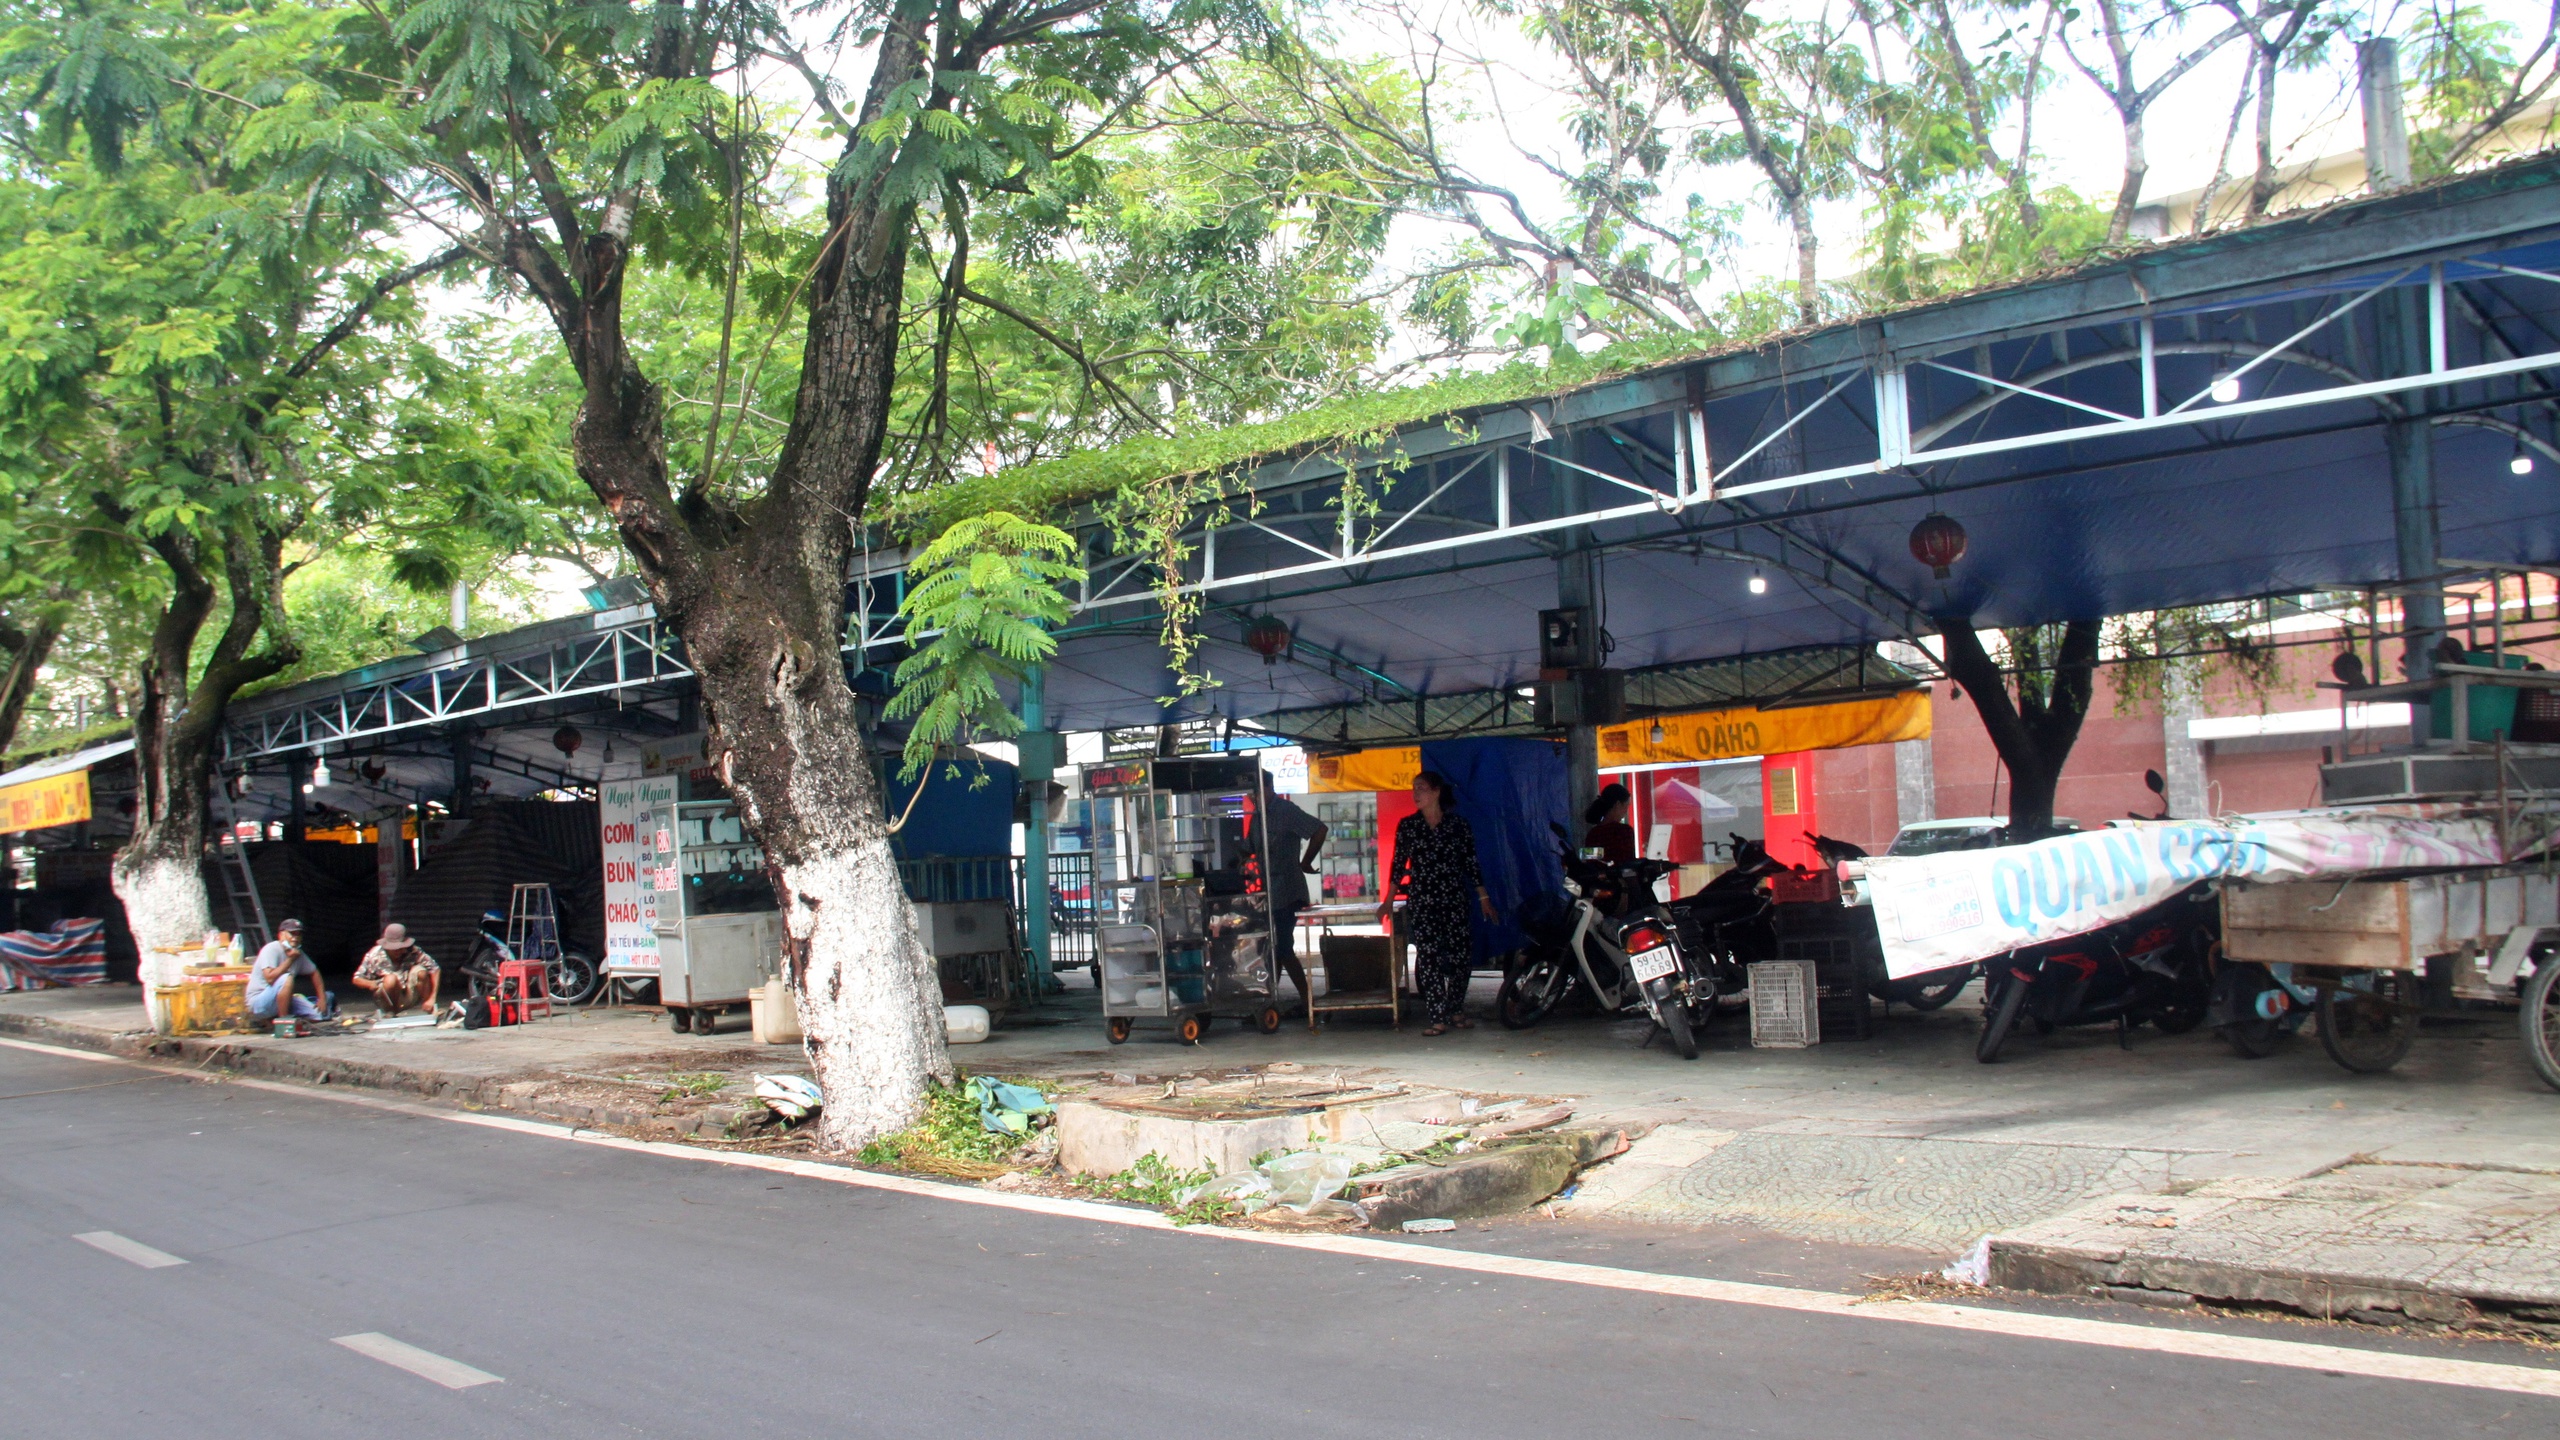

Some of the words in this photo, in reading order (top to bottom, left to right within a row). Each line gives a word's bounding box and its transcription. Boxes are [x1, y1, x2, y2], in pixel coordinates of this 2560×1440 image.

[605, 786, 635, 808] Ngọc
[638, 783, 672, 806] Ngân
[604, 821, 635, 845] CƠM
[607, 856, 635, 883] BÚN
[608, 898, 638, 923] CHÁO
